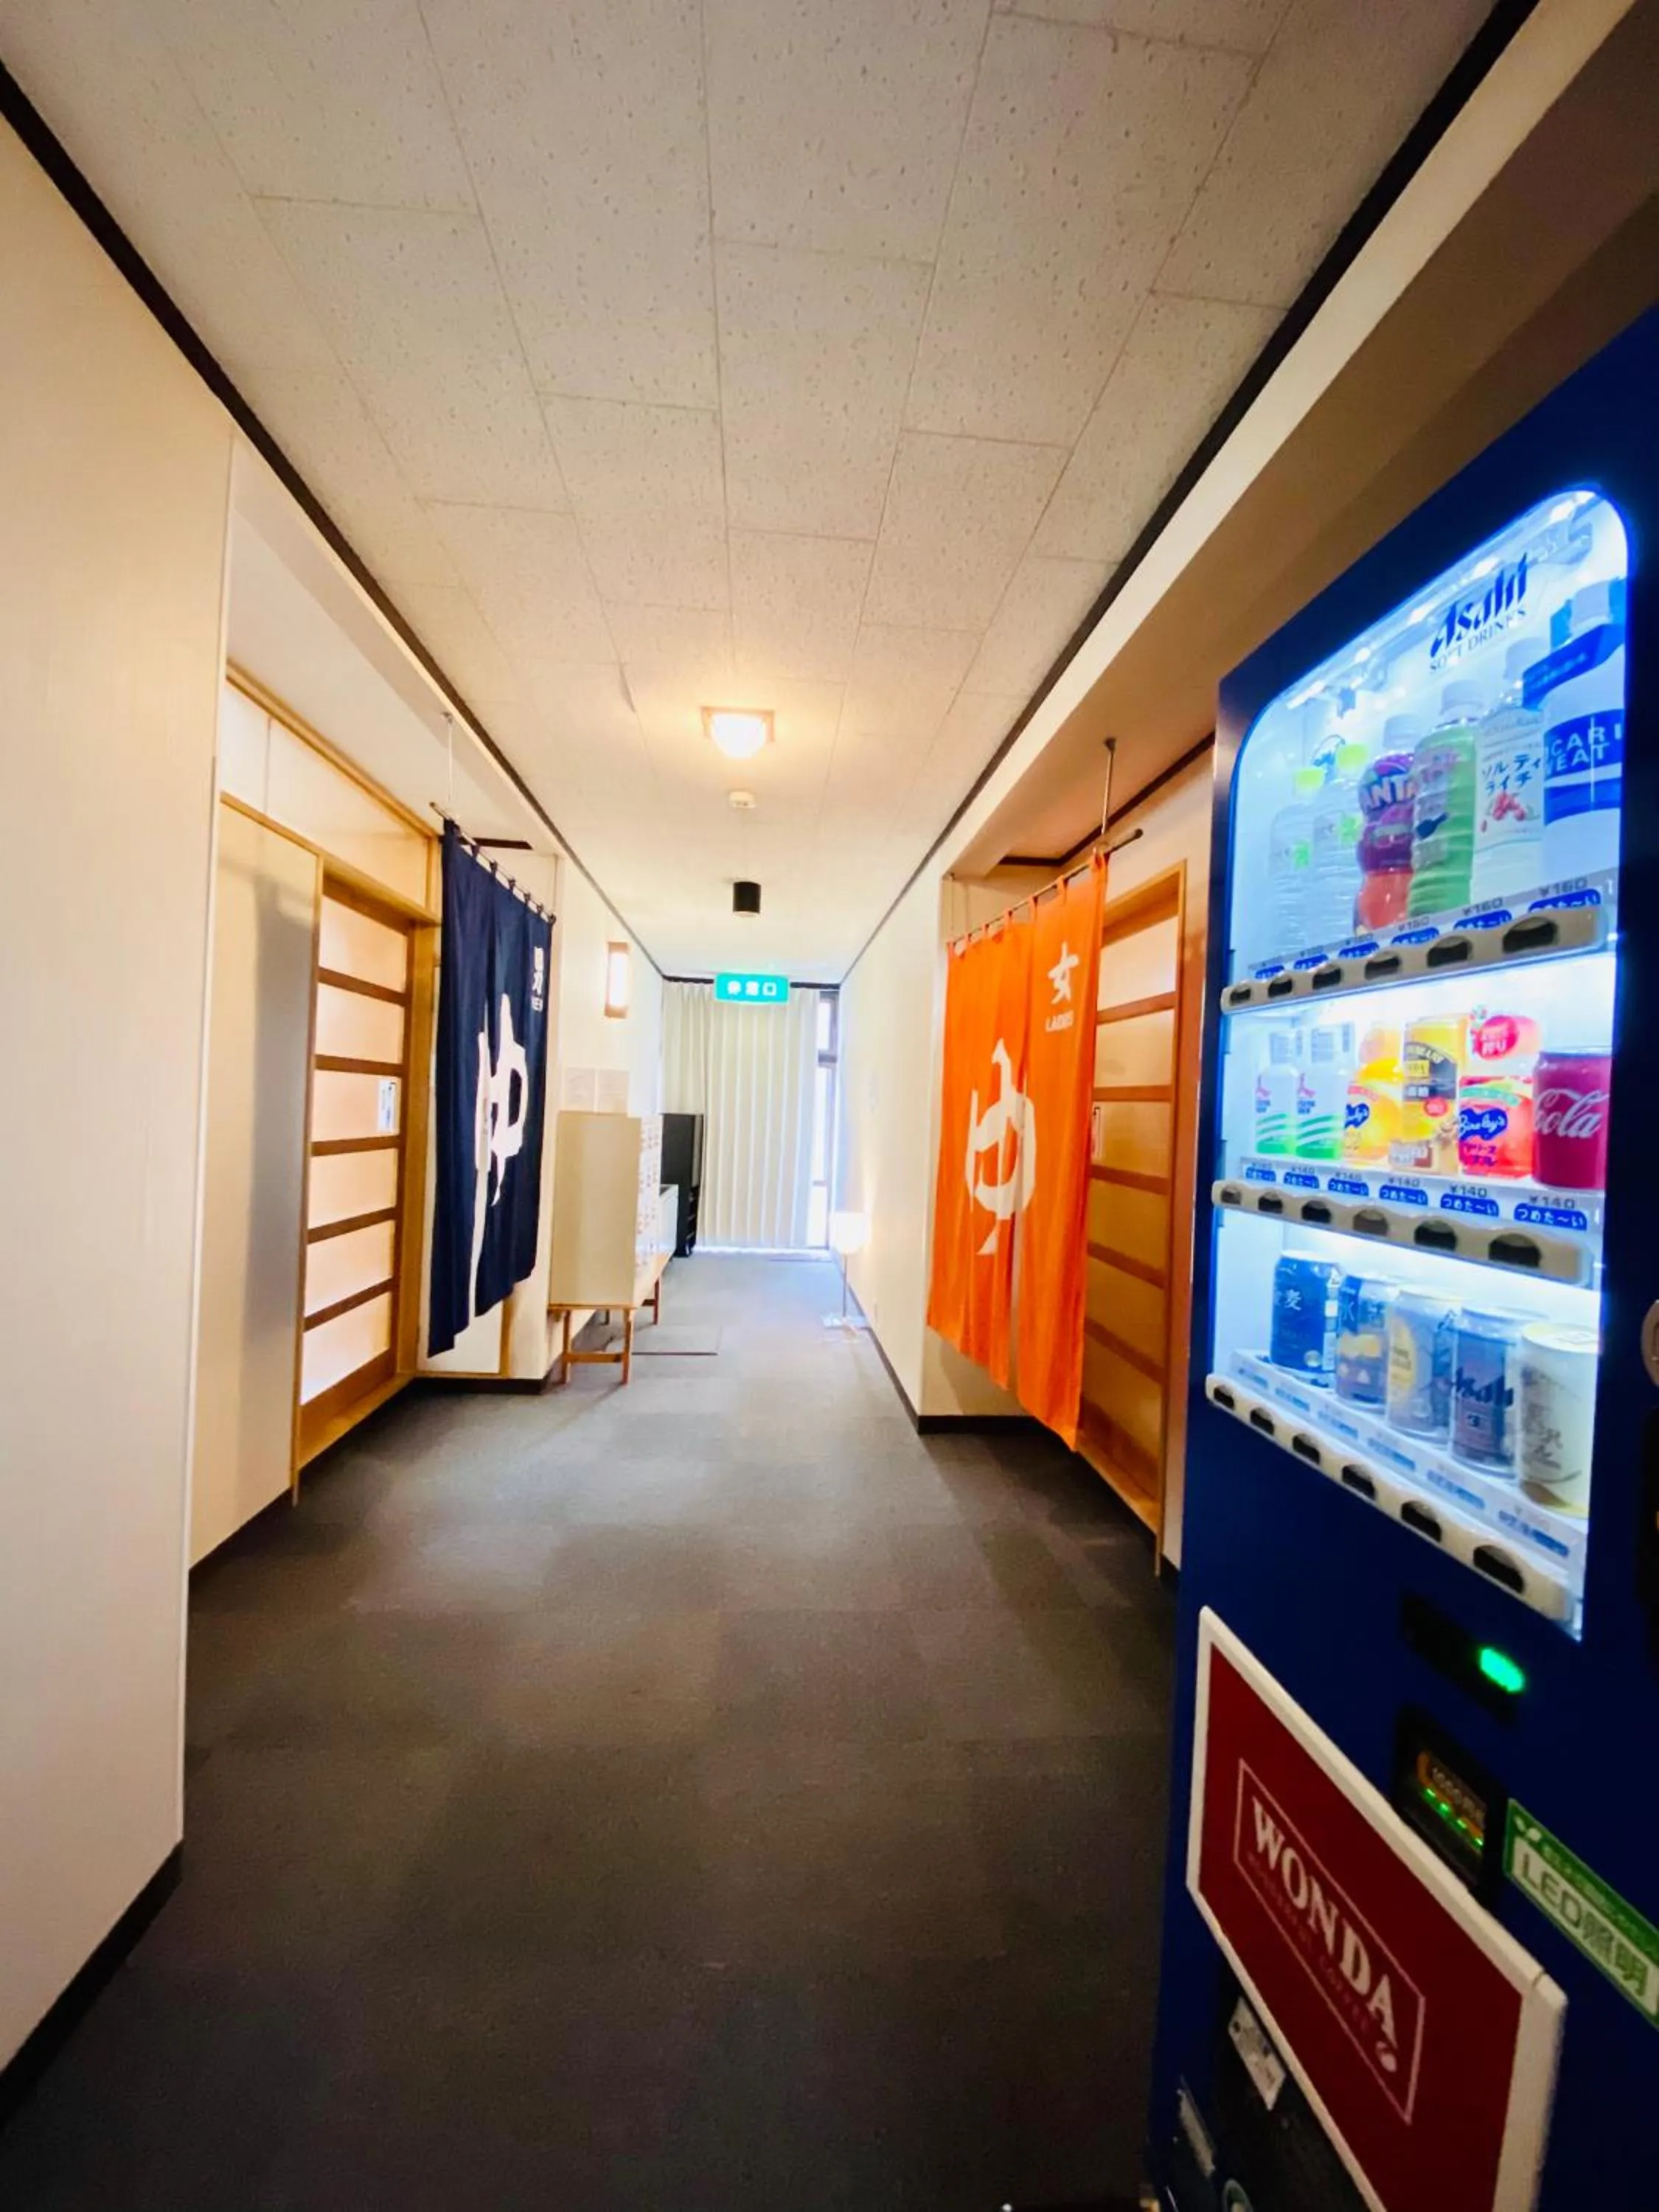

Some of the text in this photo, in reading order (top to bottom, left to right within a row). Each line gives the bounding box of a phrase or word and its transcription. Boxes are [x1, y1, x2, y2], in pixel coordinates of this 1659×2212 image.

[1430, 551, 1527, 656] Asahi
[1047, 941, 1079, 1004] 女
[964, 1037, 1037, 1256] ゆ
[1251, 1795, 1398, 2050] WONDA
